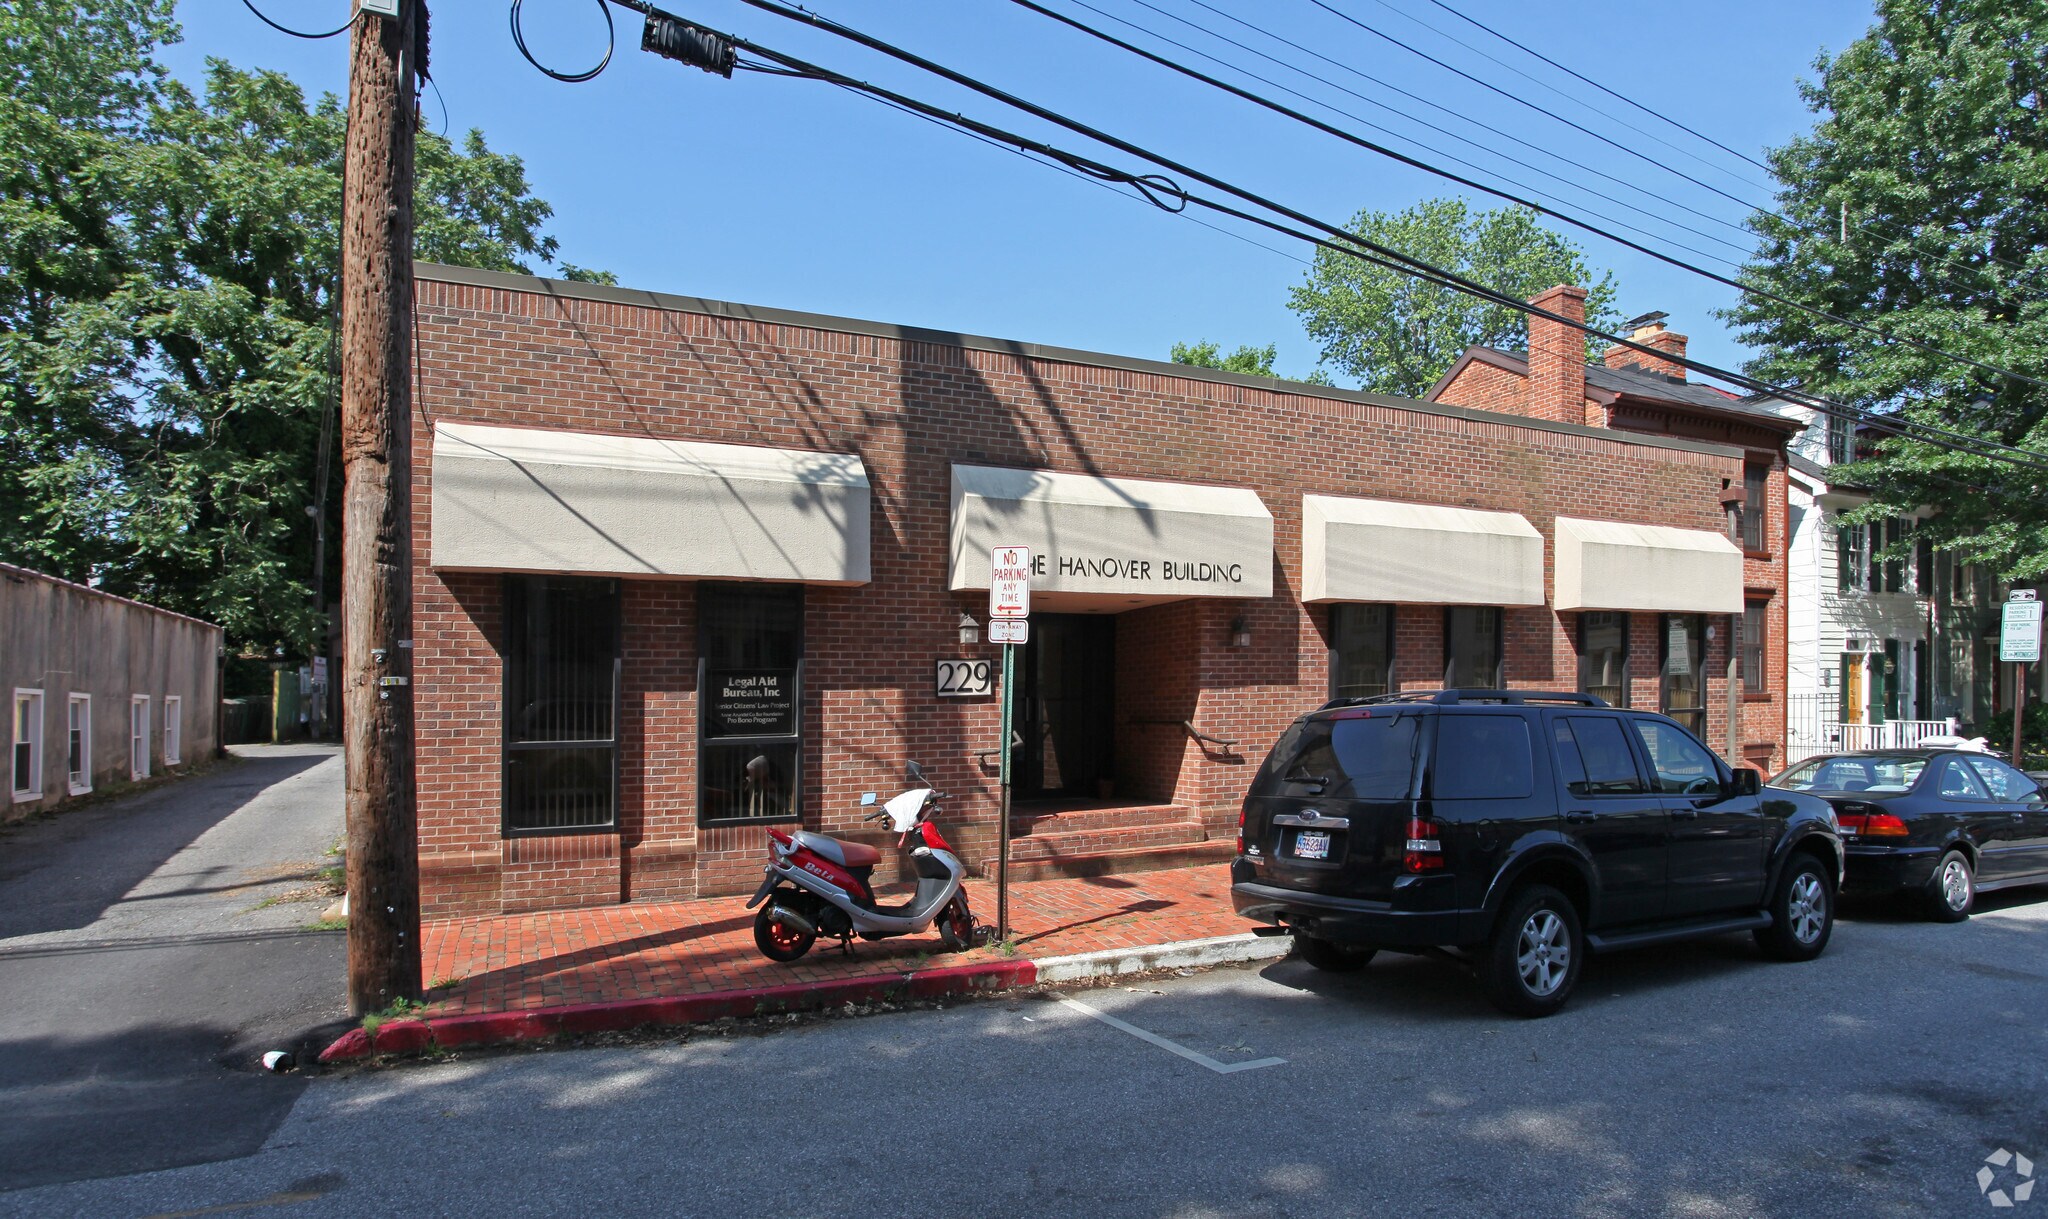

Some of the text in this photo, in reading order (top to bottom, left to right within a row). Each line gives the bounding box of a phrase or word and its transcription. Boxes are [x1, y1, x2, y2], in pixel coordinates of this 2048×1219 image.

[1003, 552, 1018, 566] NO
[1029, 554, 1242, 583] HE HANOVER BUILDING
[994, 568, 1027, 581] PARKING
[1002, 583, 1018, 592] ANY
[1001, 593, 1019, 602] TIME
[728, 676, 777, 688] Legal Aid
[939, 662, 990, 693] 229
[723, 687, 780, 698] Bureau, Inc
[770, 702, 790, 710] Project
[753, 717, 778, 725] Program
